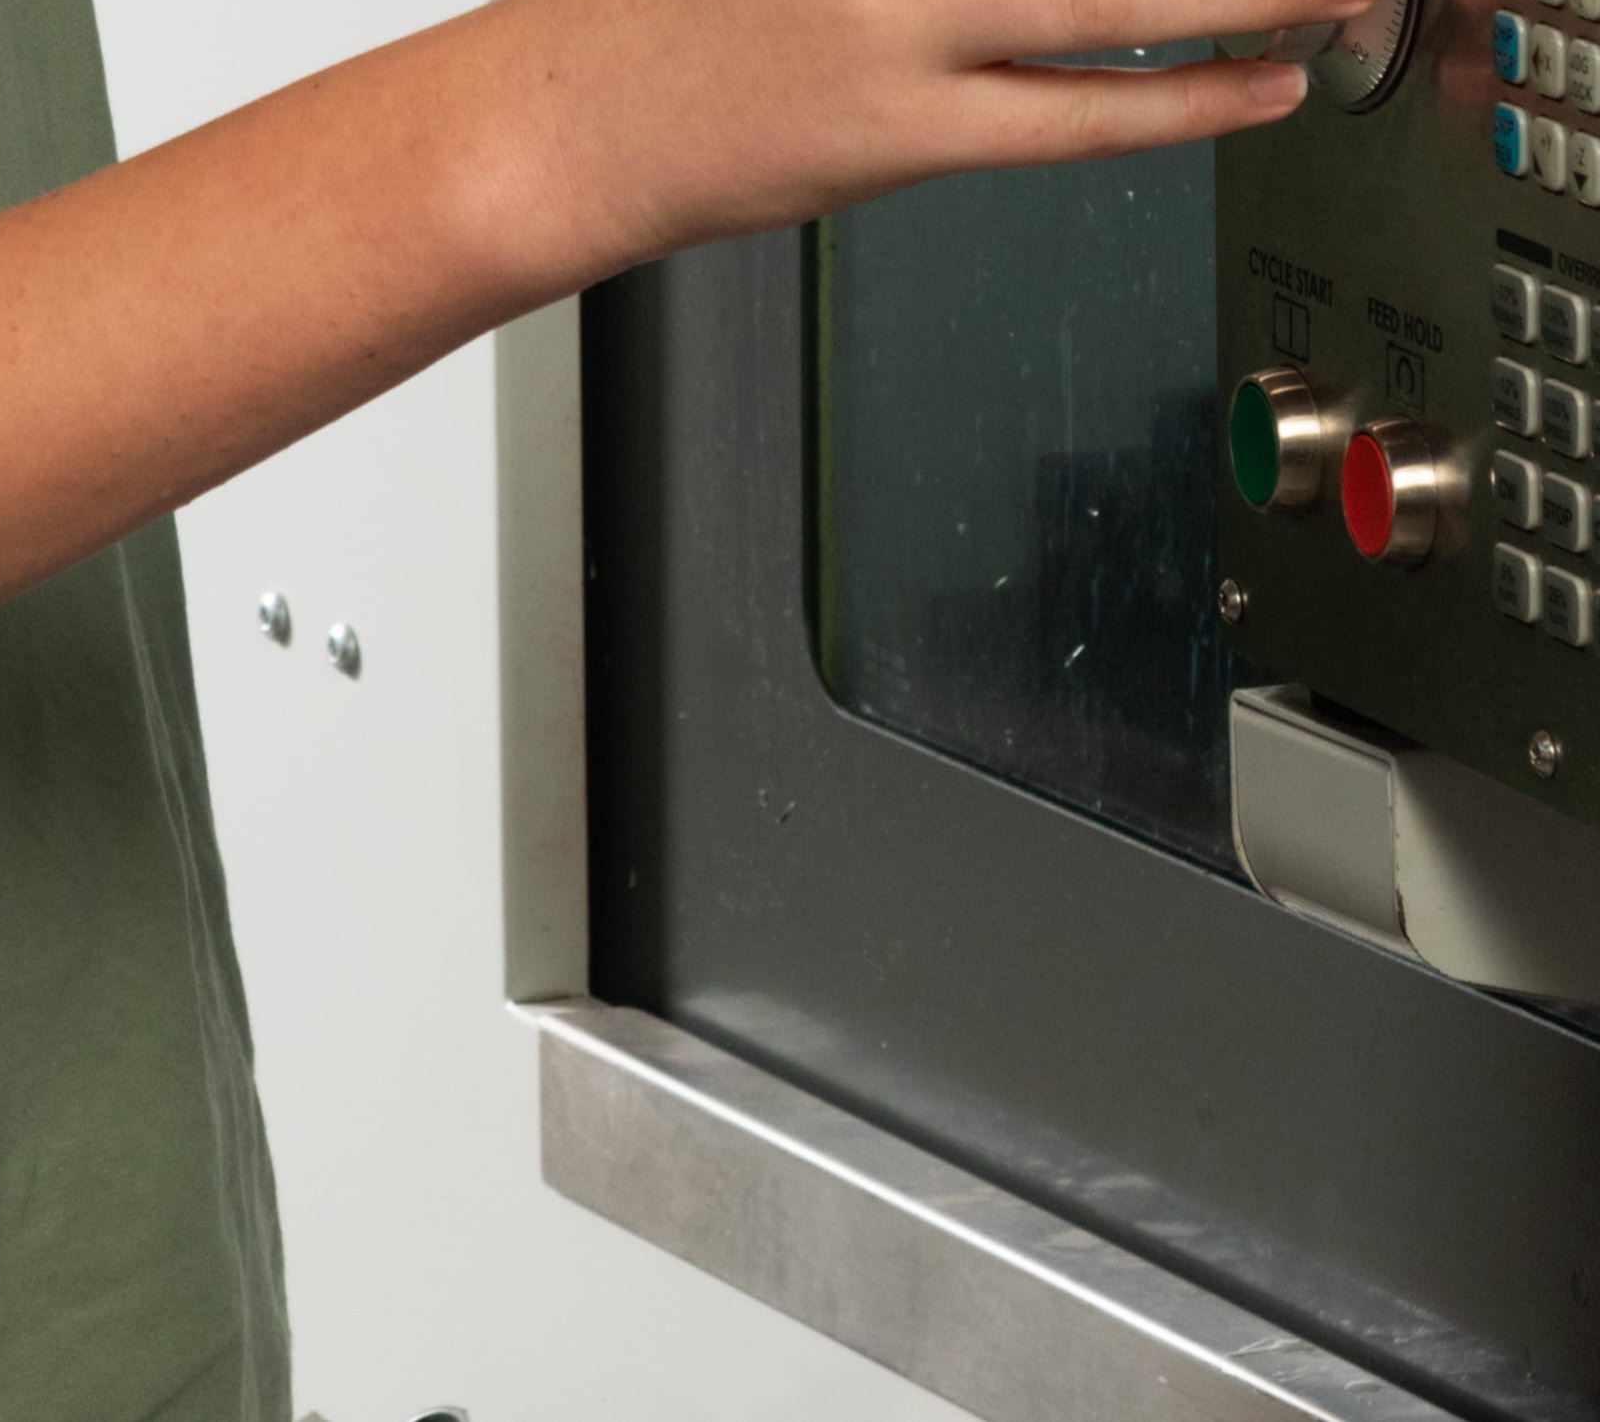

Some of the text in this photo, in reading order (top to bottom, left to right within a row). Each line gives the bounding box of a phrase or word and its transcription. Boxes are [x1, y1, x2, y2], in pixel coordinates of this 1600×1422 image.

[1249, 247, 1334, 307] CYCLE START
[1367, 297, 1443, 353] FEED HOLD
[1544, 495, 1573, 529] STOP
